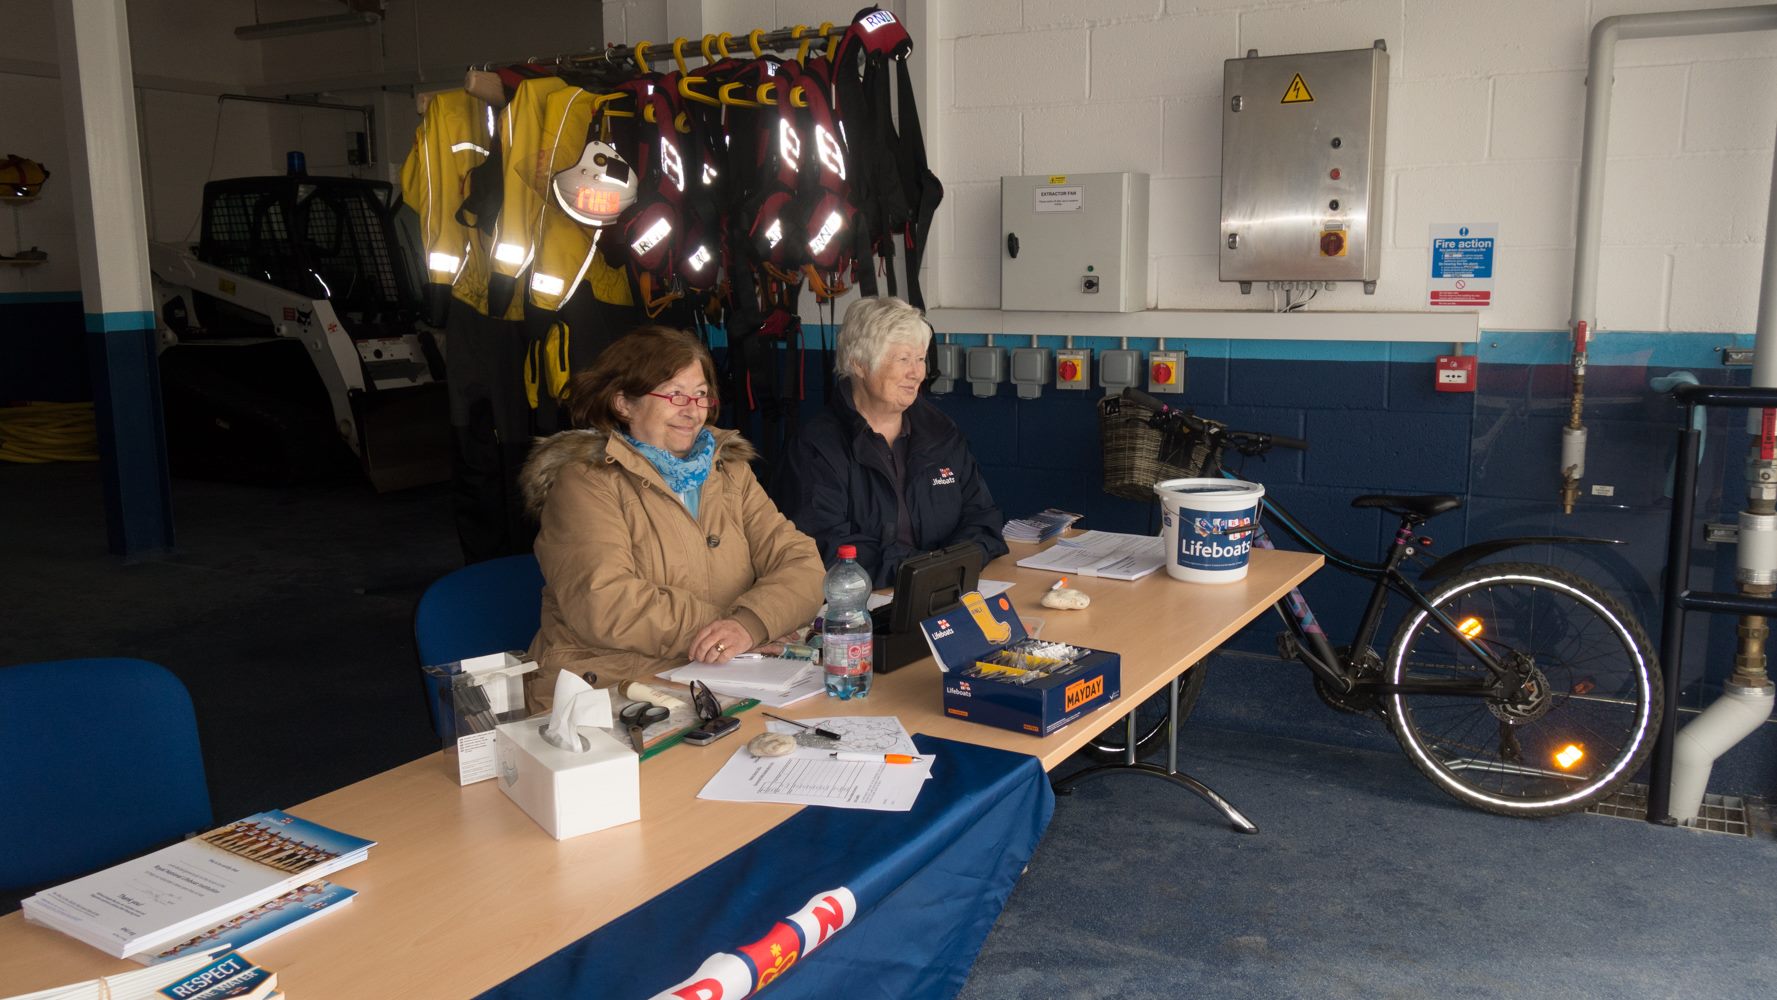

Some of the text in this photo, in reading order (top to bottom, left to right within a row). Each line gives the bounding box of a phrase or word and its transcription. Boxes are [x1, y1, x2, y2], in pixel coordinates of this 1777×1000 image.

[866, 11, 893, 27] RNLI
[1435, 239, 1492, 249] Fire action
[1182, 538, 1250, 558] Lifeboats
[931, 627, 955, 640] Lifeboats
[946, 686, 972, 698] Lifeboats
[1067, 679, 1102, 709] MAYDAY
[172, 958, 241, 998] RESPECT
[218, 970, 259, 991] WATER
